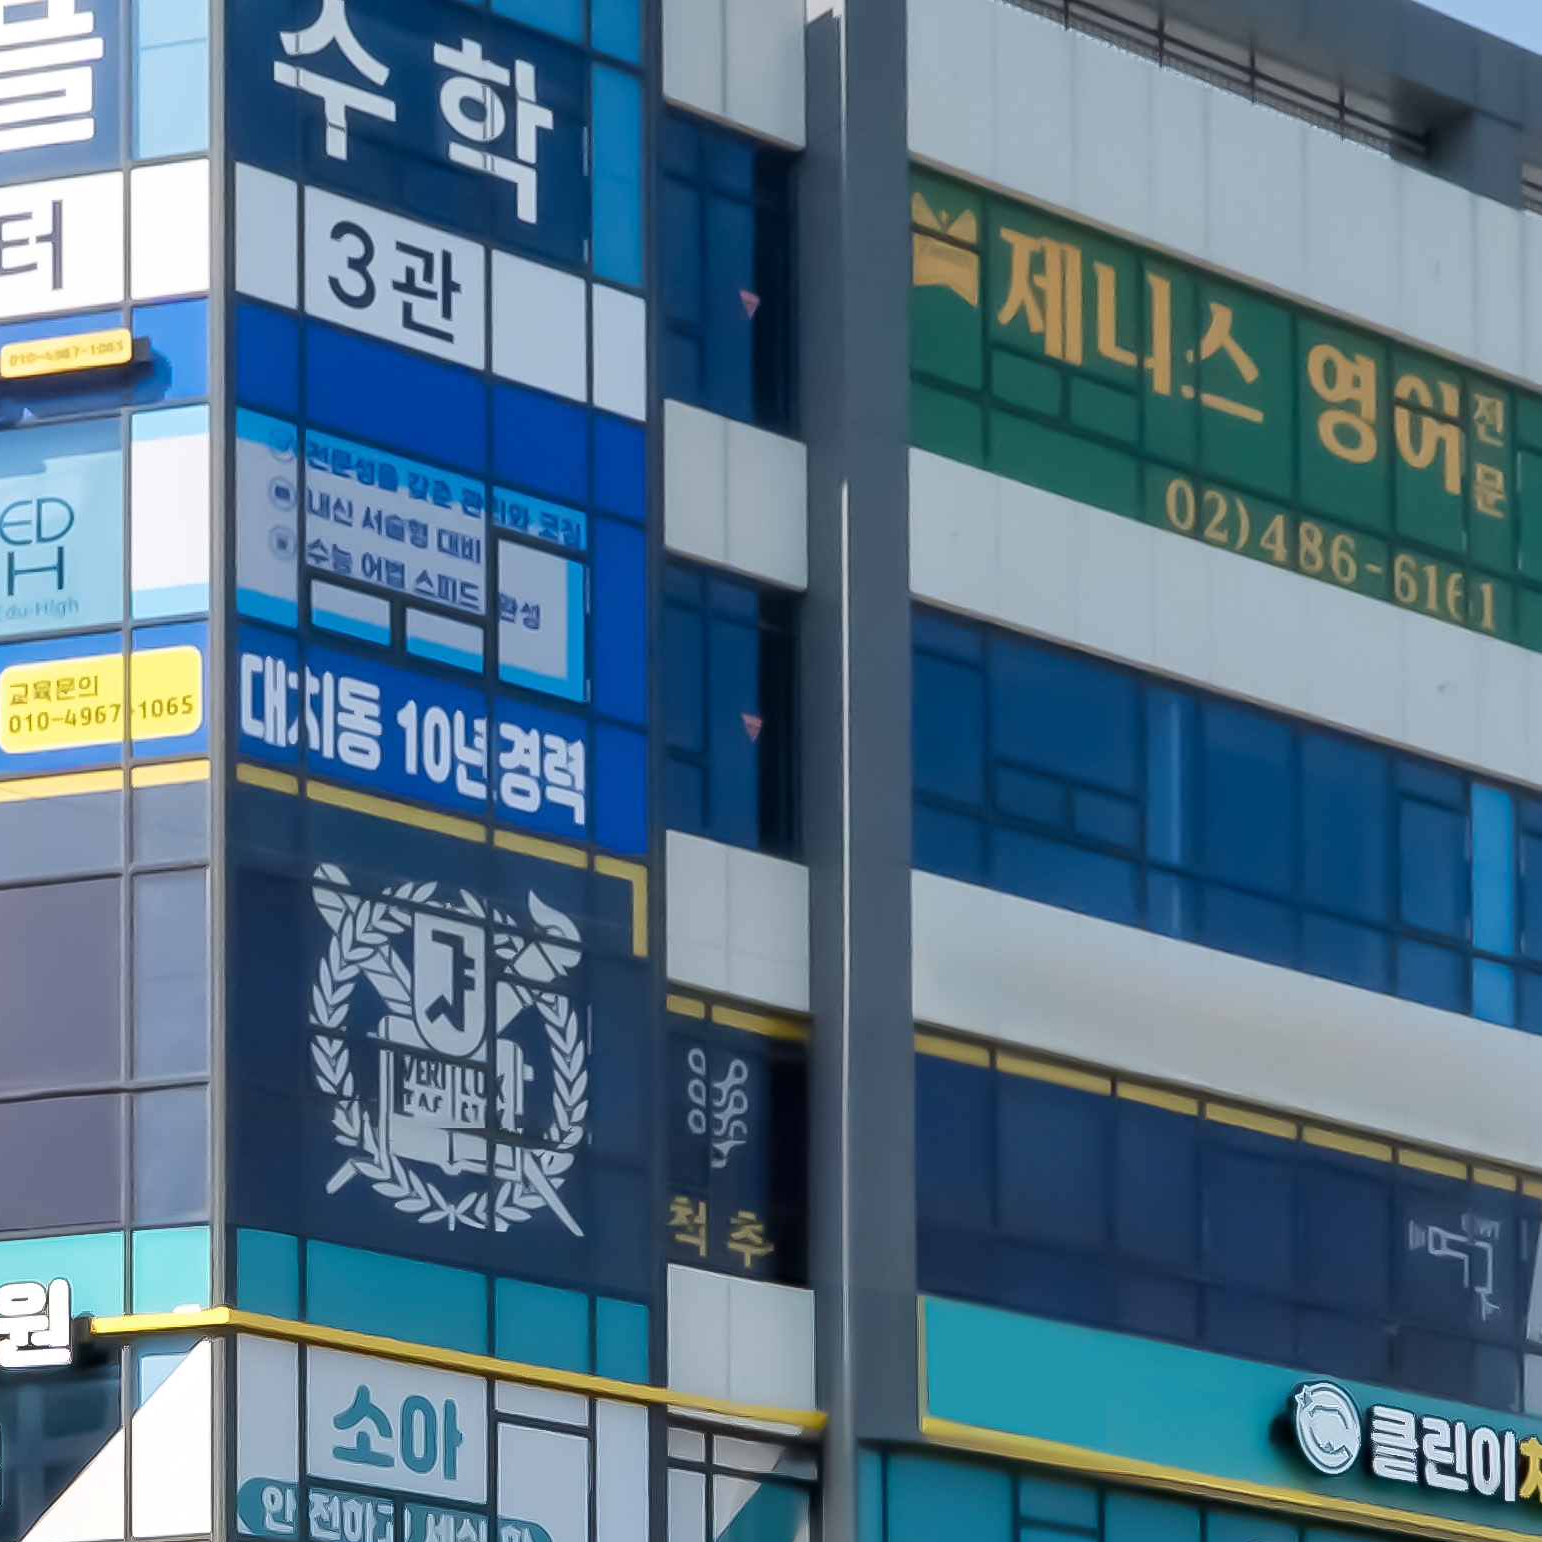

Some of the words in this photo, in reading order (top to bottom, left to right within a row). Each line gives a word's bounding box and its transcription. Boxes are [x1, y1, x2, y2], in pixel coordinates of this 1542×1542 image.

[272, 0, 555, 224] 수학
[327, 220, 463, 345] 3관
[996, 225, 1264, 424] 제니스
[1306, 344, 1466, 496] 영어
[413, 568, 480, 612] 스피드
[8, 674, 99, 706] 교육문의
[239, 651, 383, 772] 대치동
[331, 1383, 465, 1480] 소아
